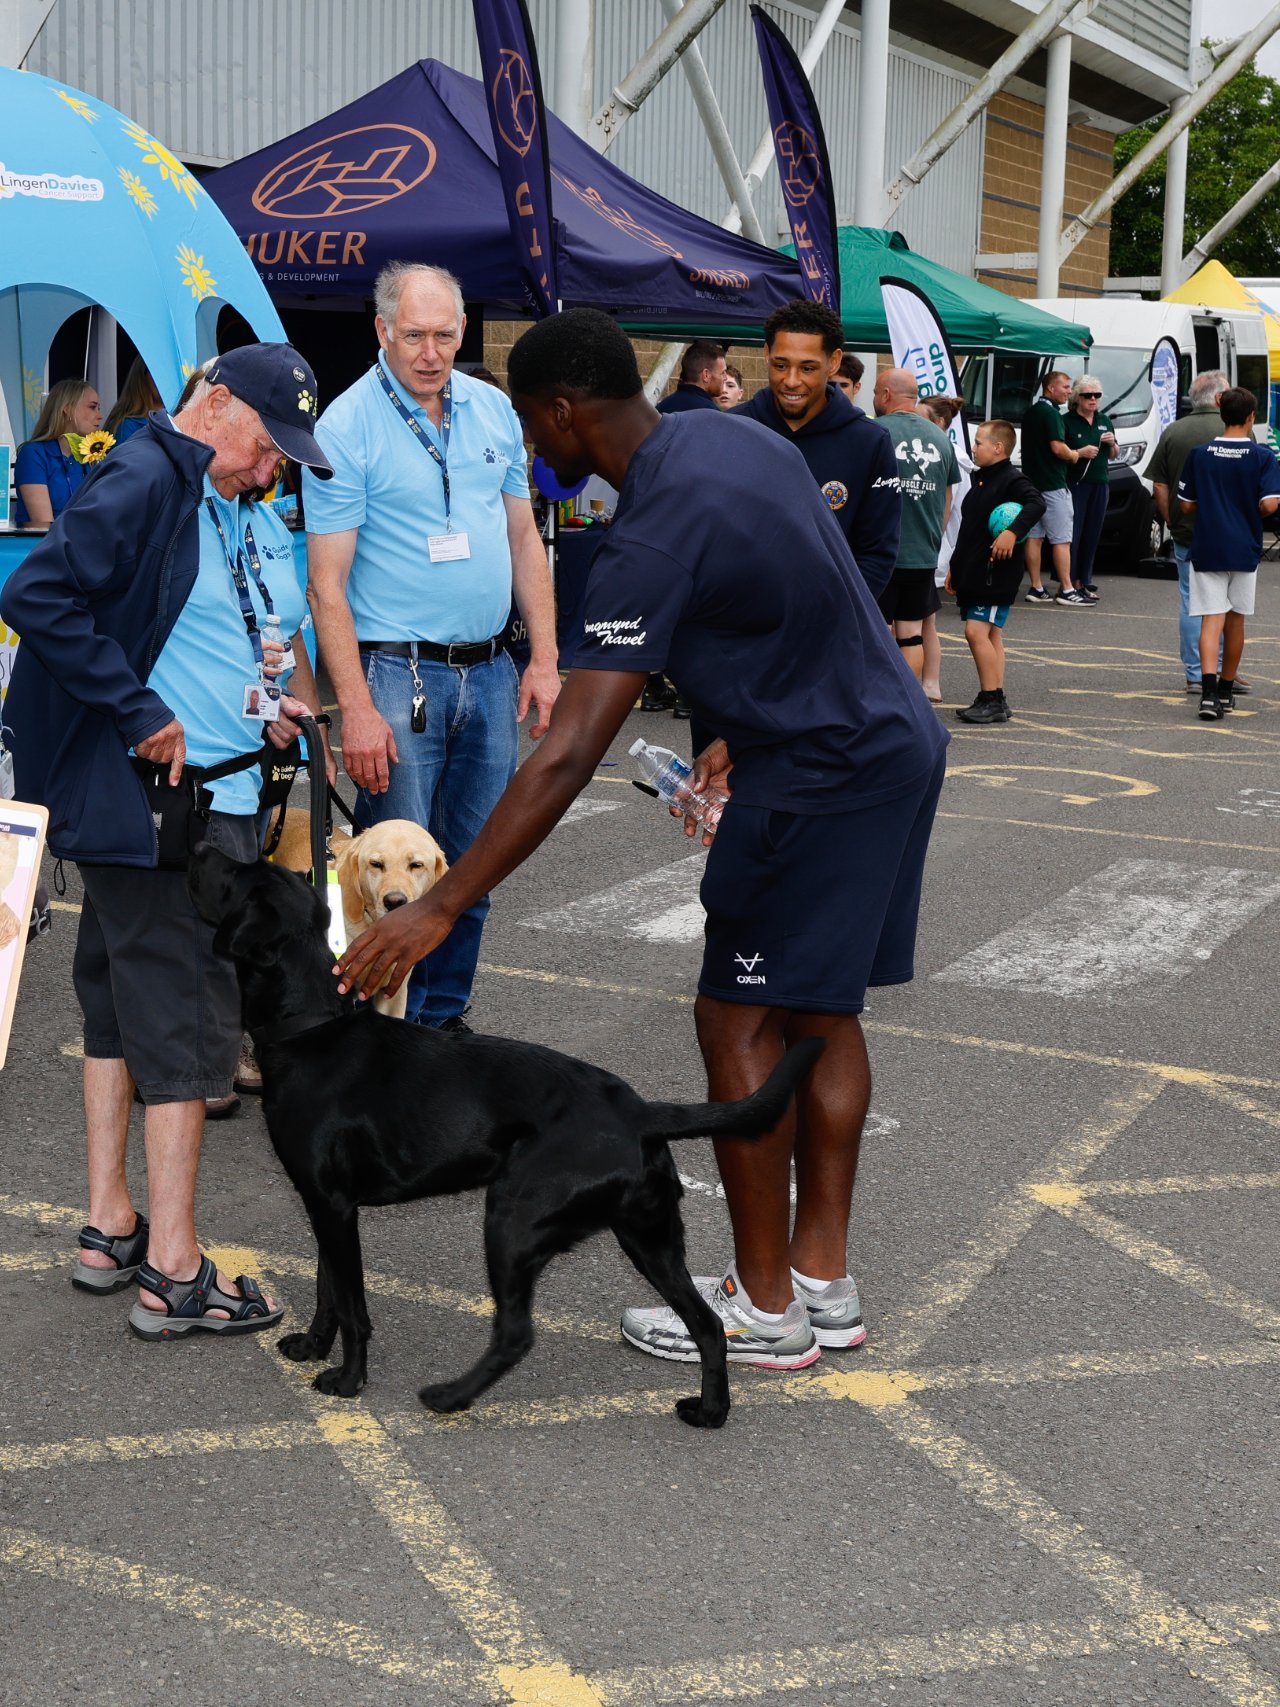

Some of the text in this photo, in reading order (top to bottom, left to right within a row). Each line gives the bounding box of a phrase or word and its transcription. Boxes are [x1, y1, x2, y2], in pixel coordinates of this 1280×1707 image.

[0, 175, 98, 191] LingenDavies
[277, 272, 340, 282] DEVELOPMENT
[928, 342, 948, 393] oup
[900, 480, 937, 491] USCLE FLEX
[272, 544, 288, 554] Guide
[276, 552, 292, 560] Dogs
[597, 631, 647, 646] Travel
[280, 765, 296, 773] Guide
[280, 771, 294, 780] Dogs
[737, 975, 766, 985] OXEN
